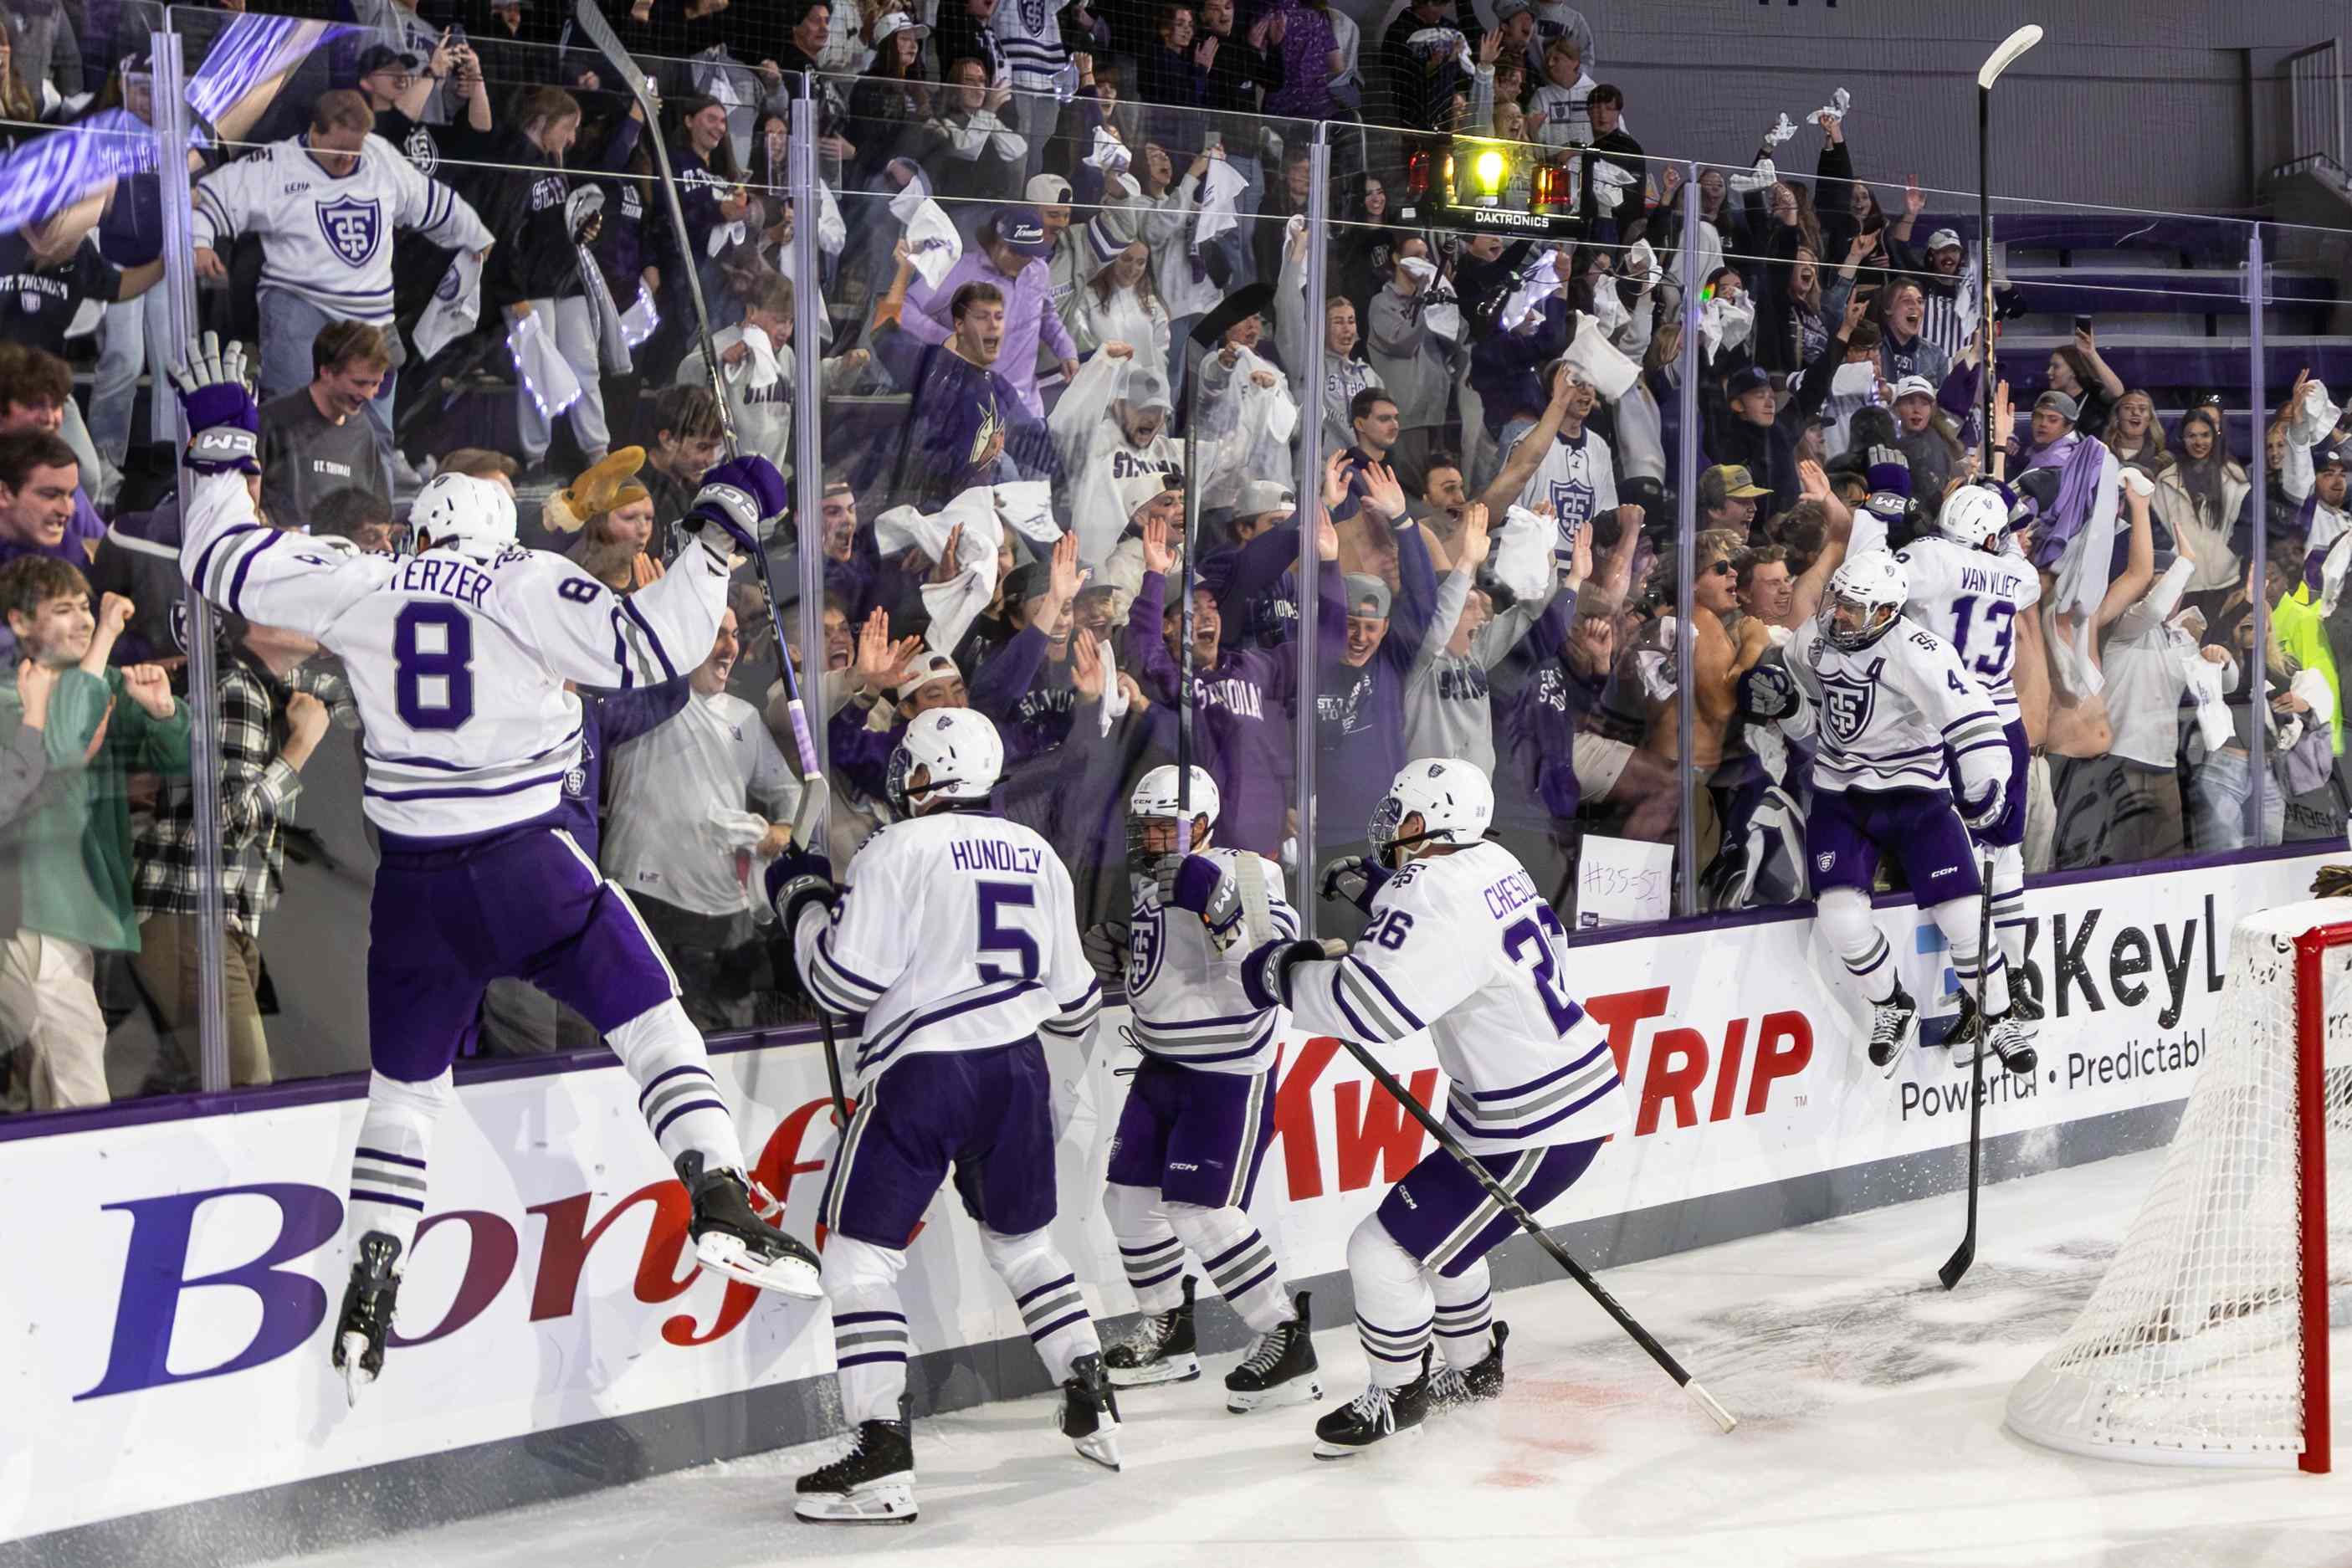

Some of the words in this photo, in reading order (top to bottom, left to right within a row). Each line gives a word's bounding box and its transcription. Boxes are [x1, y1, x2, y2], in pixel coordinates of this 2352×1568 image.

[1475, 211, 1550, 228] DAKTRONICS
[558, 576, 602, 604] 8
[1962, 567, 1988, 592] VAN
[1990, 571, 2021, 598] VLIET
[1950, 595, 2016, 676] 13
[392, 598, 475, 732] 8
[1947, 669, 1969, 694] 4
[1930, 865, 1959, 879] CCM
[976, 880, 1040, 986] 5
[1358, 906, 1415, 951] 26
[1585, 985, 1814, 1143] TRIP
[2068, 1027, 2207, 1090] Predictabl
[1170, 1162, 1199, 1171] CCM
[1398, 1185, 1418, 1210] CCM
